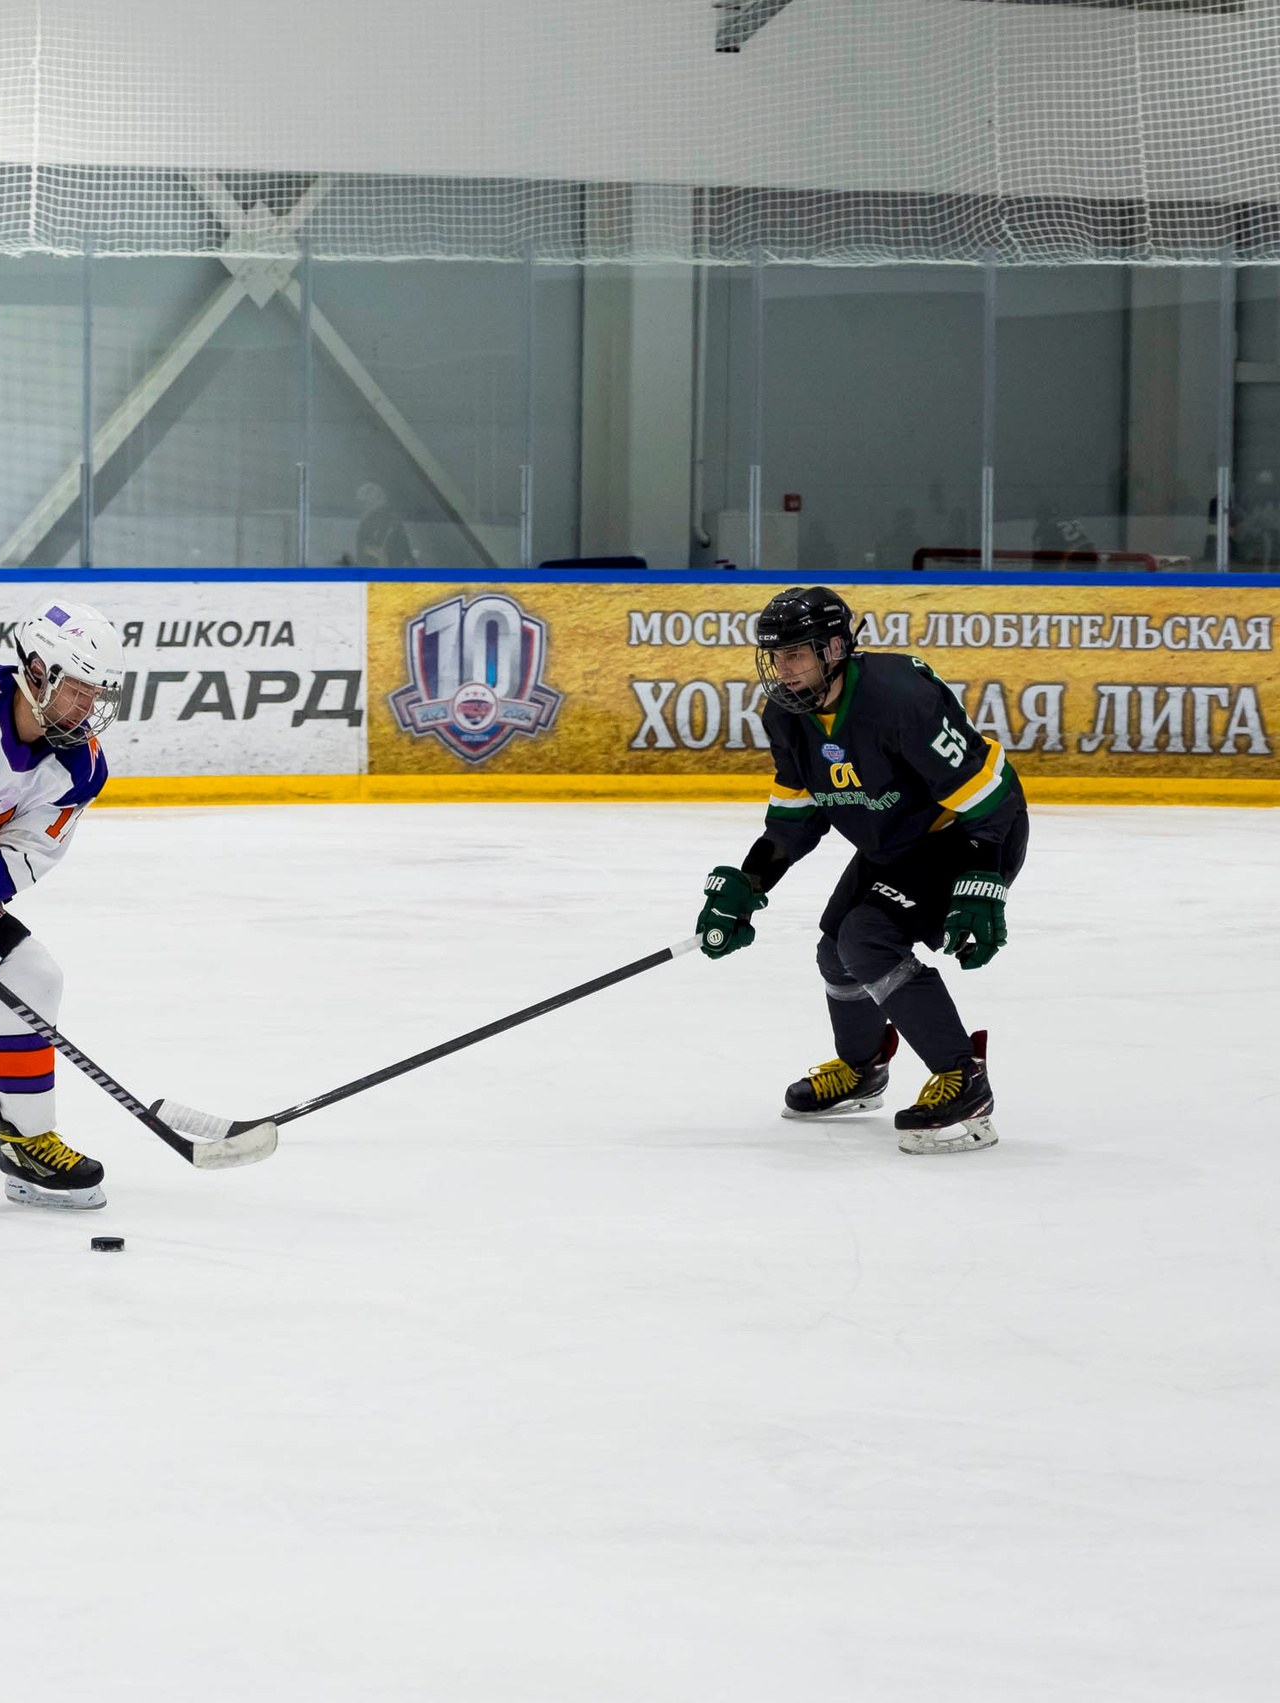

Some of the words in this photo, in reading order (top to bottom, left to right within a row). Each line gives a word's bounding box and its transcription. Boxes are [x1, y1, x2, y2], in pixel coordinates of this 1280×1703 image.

[155, 620, 295, 648] ШКОЛА
[425, 594, 522, 700] 10
[629, 611, 910, 646] МОСКАЯ
[920, 613, 1272, 651] ЛЮБИТЕЛЬСКАЯ
[630, 680, 1064, 752] ХОКАЯ
[1080, 684, 1270, 754] ЛИГА
[871, 881, 916, 908] CCM
[11, 1004, 145, 1117] WARRIOR
